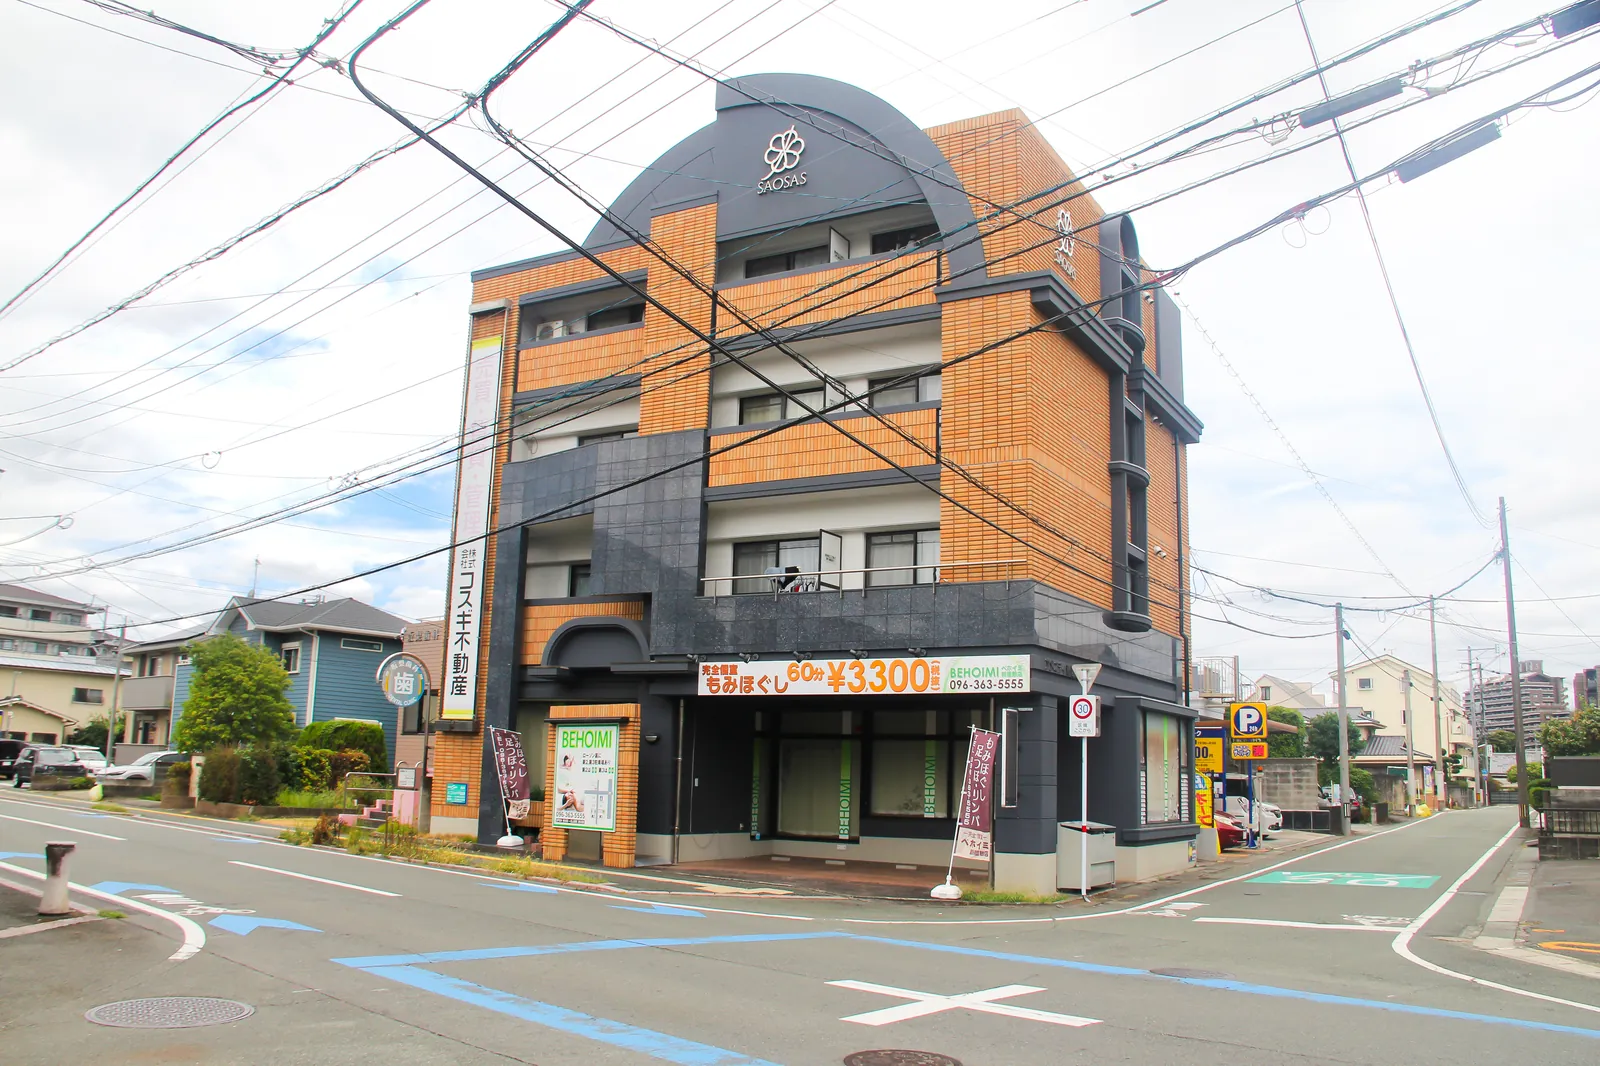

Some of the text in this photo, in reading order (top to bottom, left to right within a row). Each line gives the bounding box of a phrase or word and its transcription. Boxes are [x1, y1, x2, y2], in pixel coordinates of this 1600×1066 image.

[757, 172, 807, 195] SAOSAS
[451, 549, 477, 696] 株式会社 コスギ不動産
[702, 664, 738, 676] 完全個室
[787, 662, 825, 682] 60分
[827, 659, 931, 693] ¥3,300
[950, 667, 1000, 679] BEHOIMI
[394, 672, 415, 695] 歯
[706, 675, 789, 694] もみほぐし
[950, 679, 1024, 690] 096-363-5555
[1077, 704, 1089, 714] 30
[1238, 709, 1260, 732] P
[561, 730, 612, 749] BEHOIMI
[979, 737, 995, 801] もみほぐし
[923, 756, 936, 815] BEHOIMI
[751, 776, 760, 834] BEHOIMI
[839, 779, 850, 835] BEHOIMI
[961, 838, 990, 850] ベホイミ
